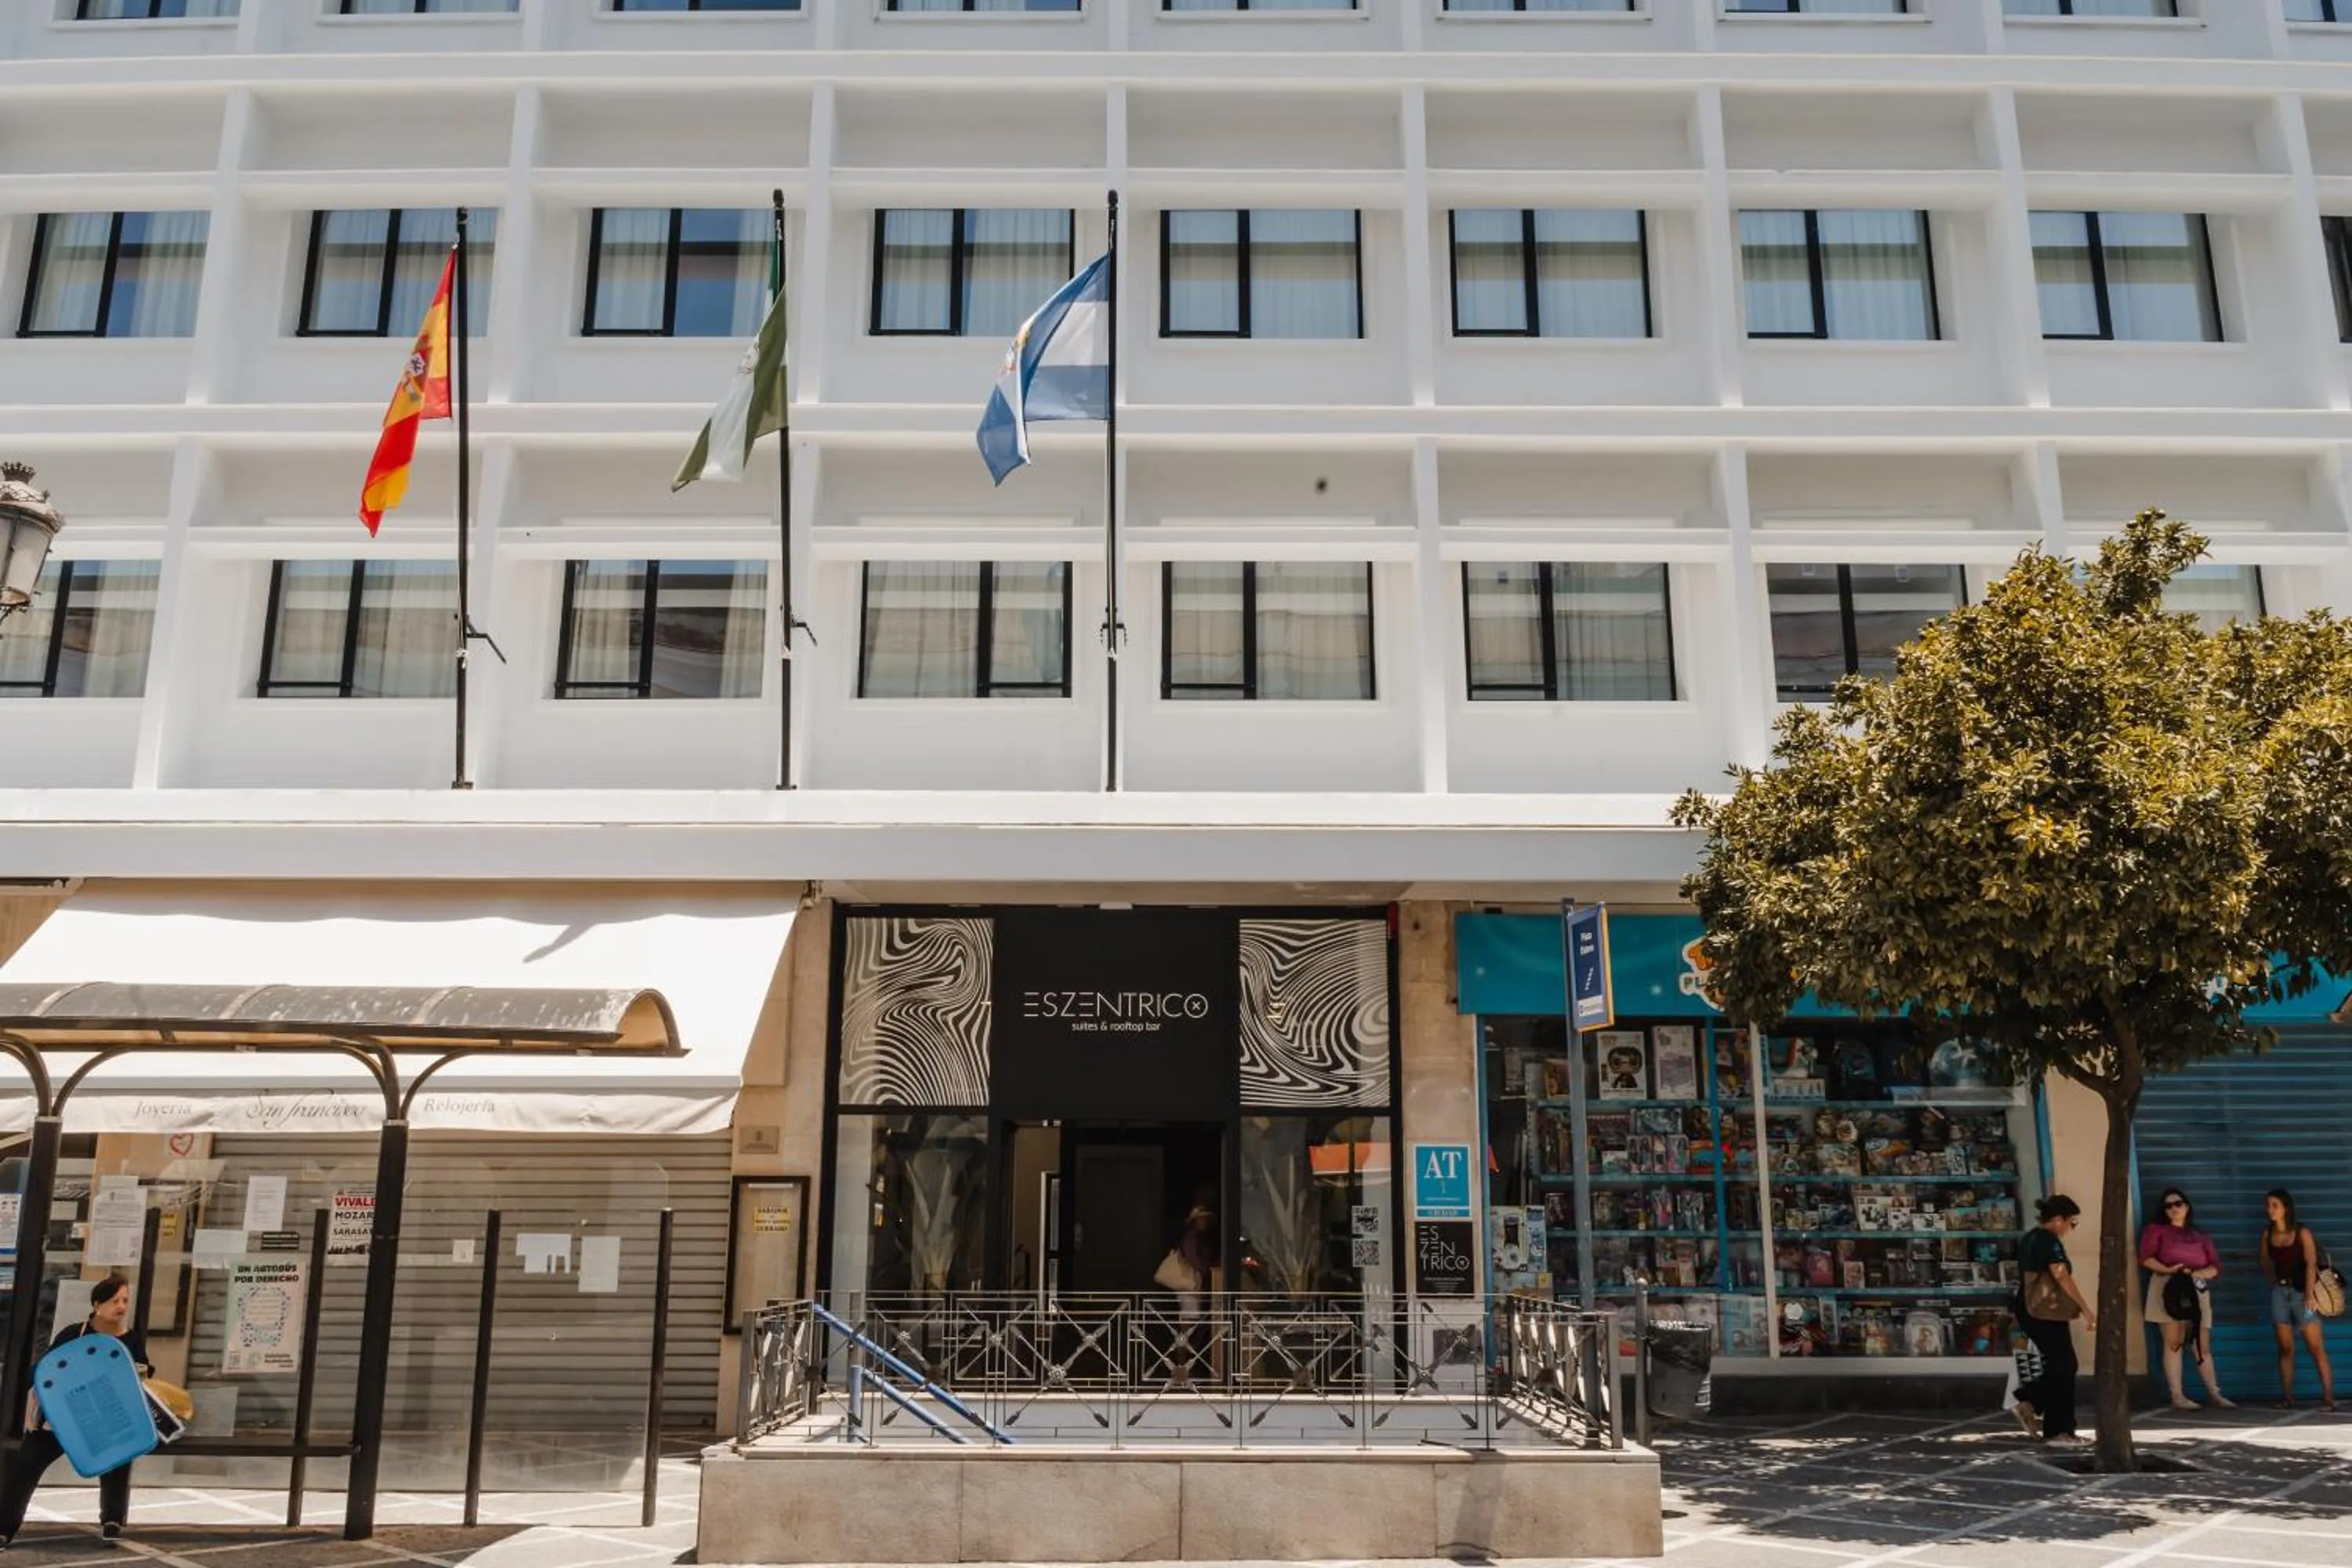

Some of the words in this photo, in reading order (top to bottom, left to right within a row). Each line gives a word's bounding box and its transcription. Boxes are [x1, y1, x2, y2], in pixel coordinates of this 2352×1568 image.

[1023, 992, 1208, 1018] ESZENTRICO
[1072, 1022, 1098, 1031] suites
[1100, 1022, 1108, 1031] &
[1110, 1021, 1144, 1033] rooftop
[1145, 1021, 1161, 1031] bar
[1424, 1150, 1462, 1179] AT
[335, 1197, 377, 1206] VIVALD
[335, 1211, 374, 1220] MOZAR
[1420, 1225, 1439, 1241] ES
[1420, 1242, 1456, 1256] ZEN
[1420, 1255, 1470, 1271] TRICO
[256, 1274, 299, 1283] DERECHO
